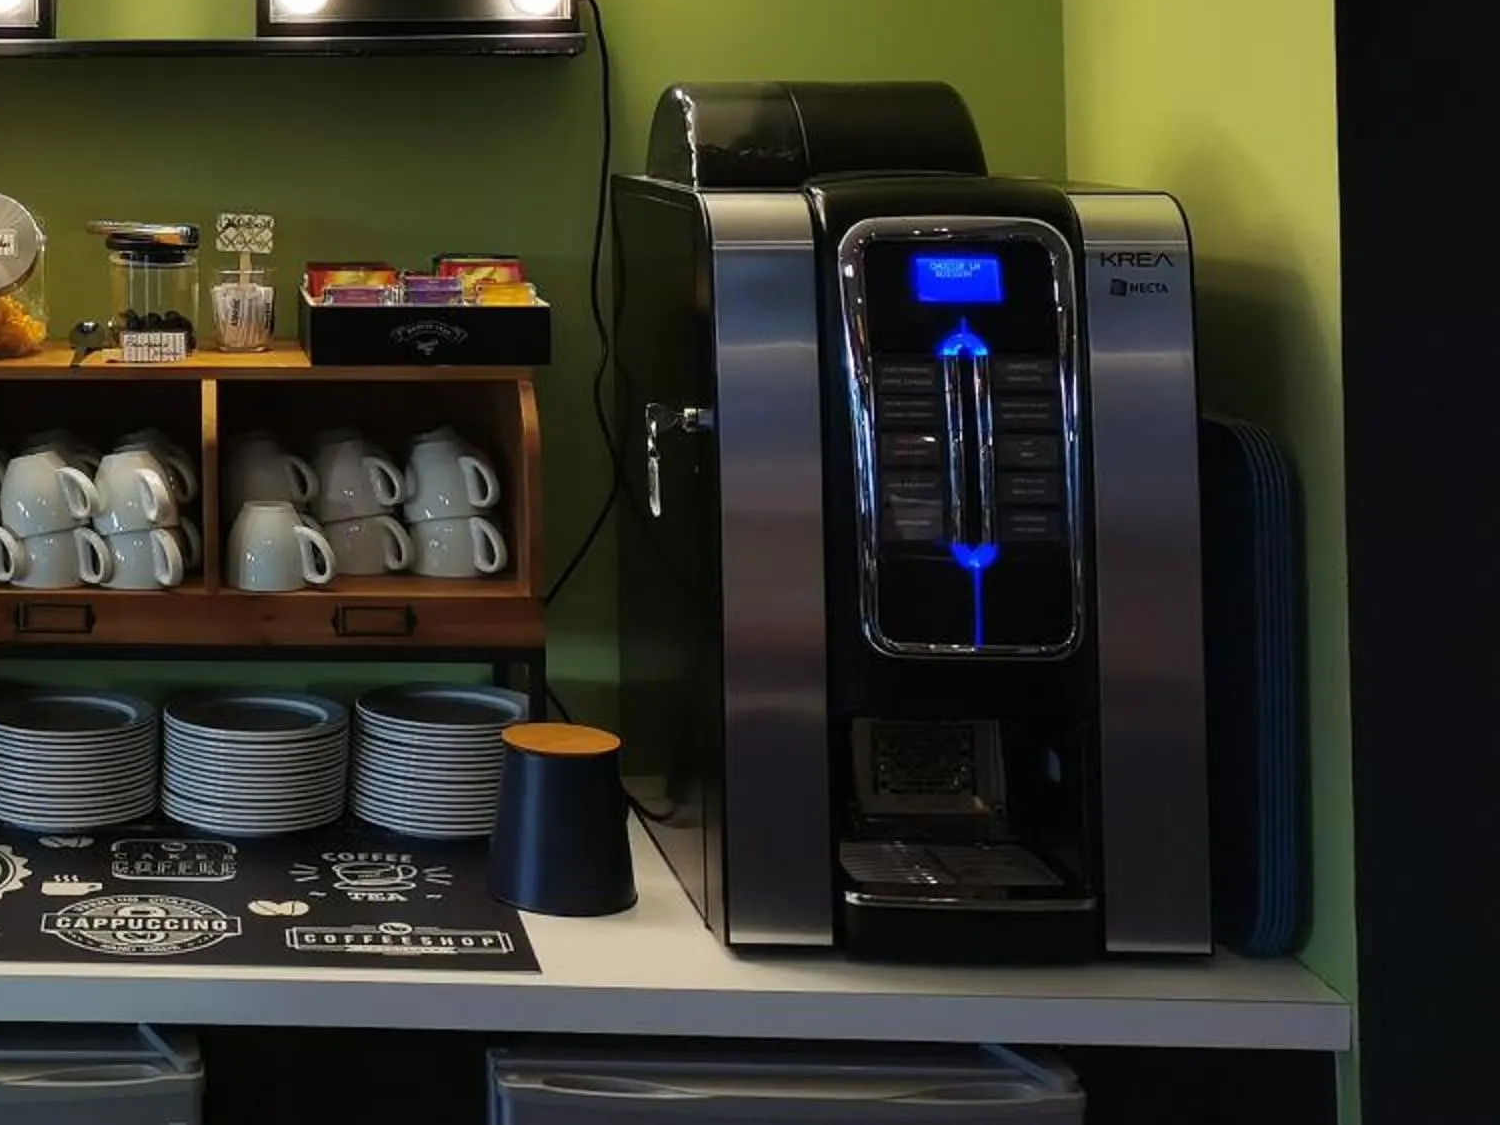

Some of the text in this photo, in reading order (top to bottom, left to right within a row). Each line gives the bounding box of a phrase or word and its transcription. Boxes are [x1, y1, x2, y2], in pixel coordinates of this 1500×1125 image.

[1100, 251, 1175, 268] KREA
[1129, 282, 1170, 294] NECTA
[320, 852, 414, 864] COFFEE
[346, 891, 409, 902] TEA
[55, 916, 228, 931] CAPPUCCINO
[303, 933, 496, 948] COFFEESHOP
